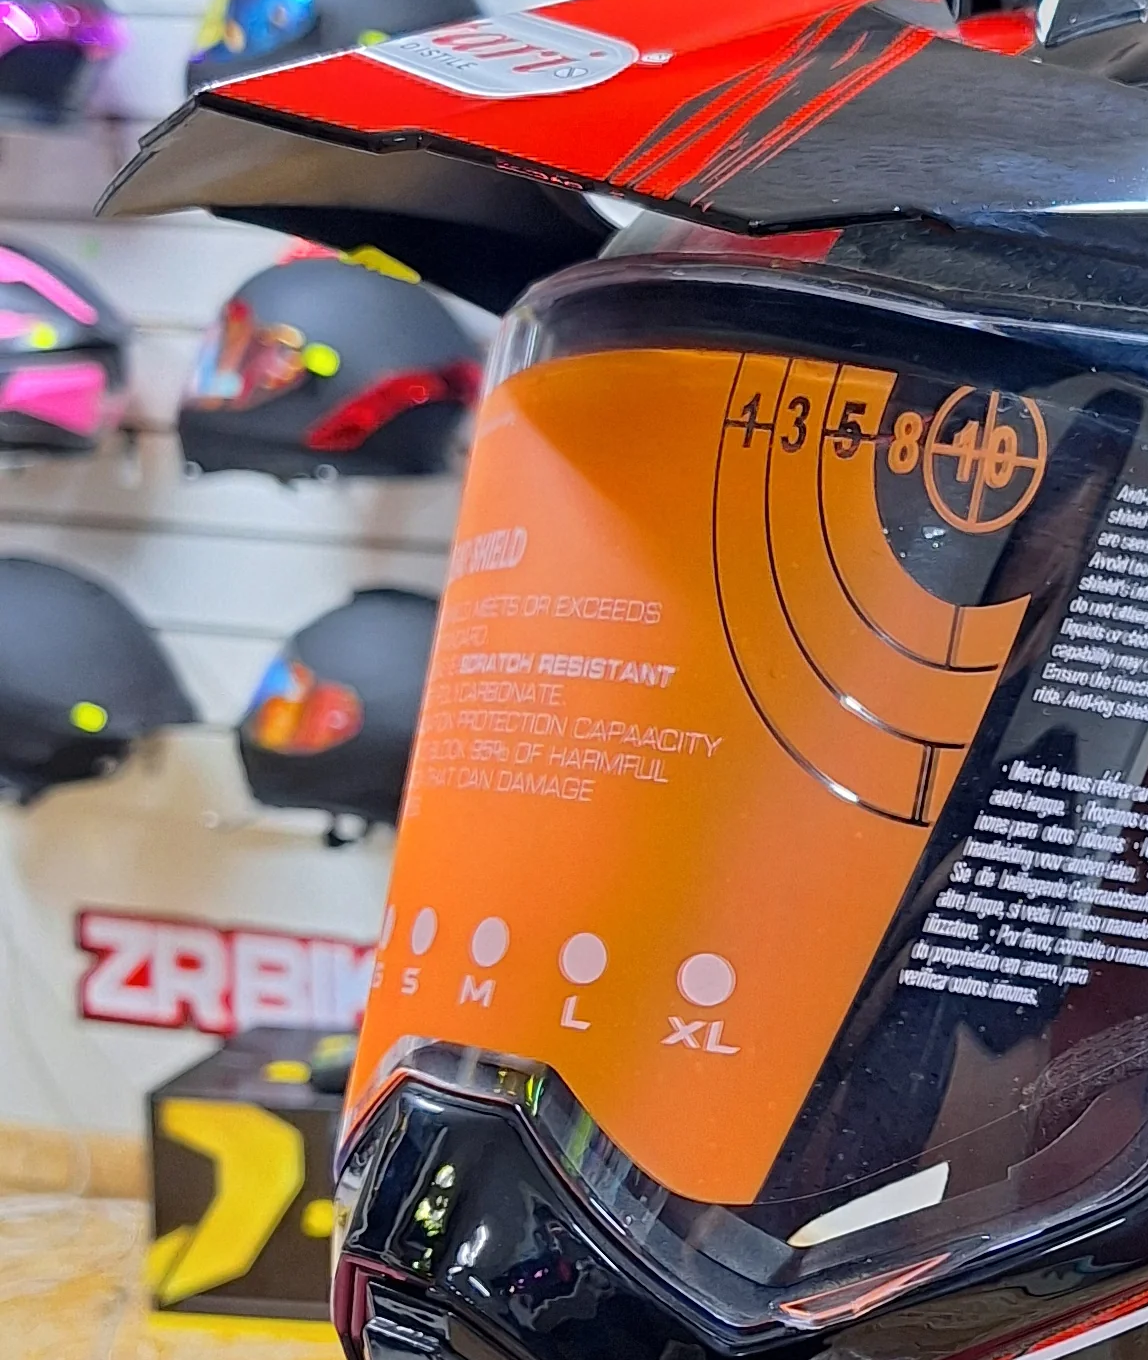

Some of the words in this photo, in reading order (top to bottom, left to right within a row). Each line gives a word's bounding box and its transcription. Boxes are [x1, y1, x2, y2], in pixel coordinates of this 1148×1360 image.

[780, 396, 811, 454] 3
[833, 401, 867, 460] 5
[888, 410, 924, 474] 8
[1089, 551, 1130, 573] Avoid
[554, 596, 662, 625] EXCEEDS
[1061, 618, 1107, 641] liquids
[538, 654, 677, 689] RESISTANT
[1052, 644, 1114, 669] capability
[1042, 662, 1089, 686] Ensure
[1033, 686, 1061, 705] ride.
[1063, 691, 1115, 718] Anti-fog
[457, 709, 567, 738] PROTECTION
[572, 717, 722, 759] CAPAACITY
[514, 742, 545, 764] OF
[549, 749, 669, 784] HARMFUL
[497, 771, 597, 803] DAMAGE
[458, 974, 497, 1009] M
[560, 995, 592, 1031] L
[661, 1016, 742, 1055] XL
